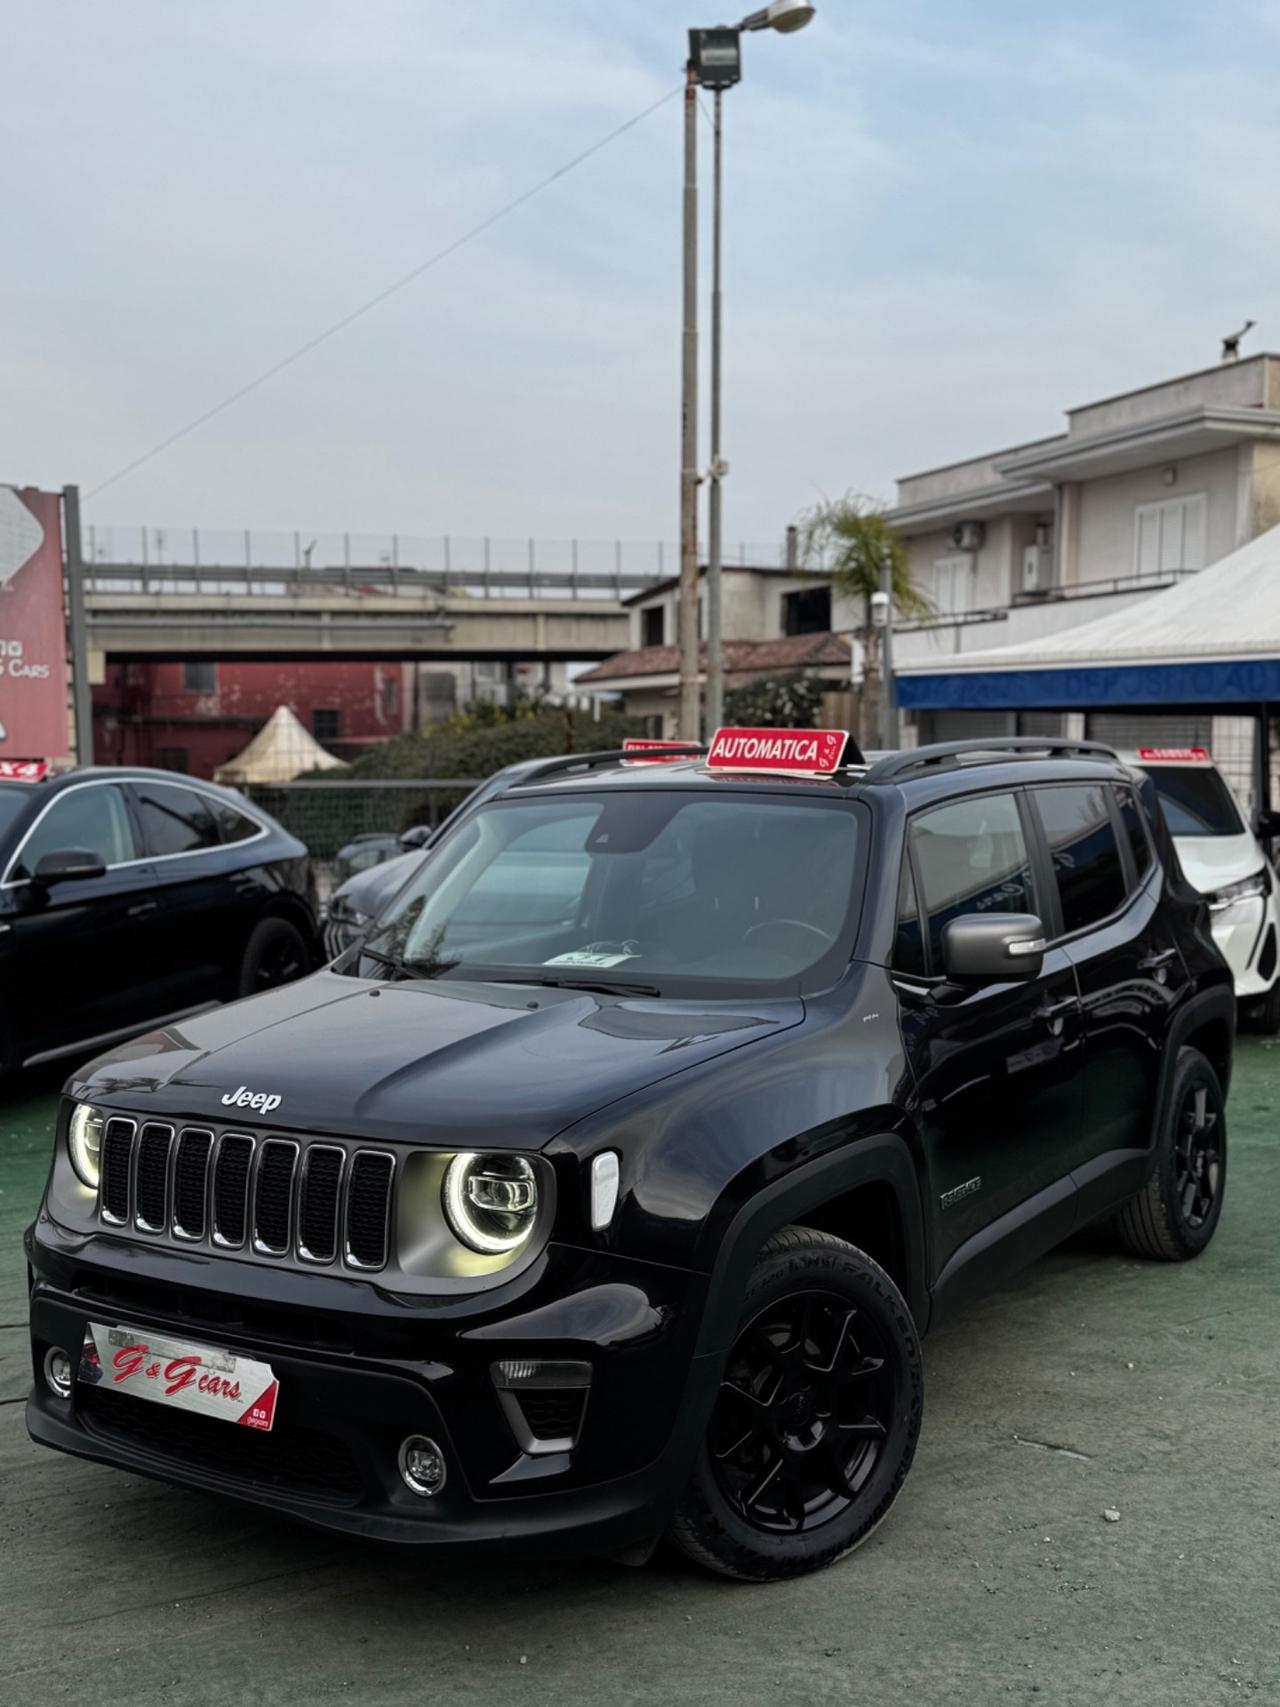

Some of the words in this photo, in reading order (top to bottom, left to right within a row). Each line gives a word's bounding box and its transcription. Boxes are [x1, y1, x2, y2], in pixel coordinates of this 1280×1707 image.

[712, 738, 818, 761] AUTOMATICA
[221, 1086, 282, 1115] Jeep
[198, 1374, 242, 1401] cars
